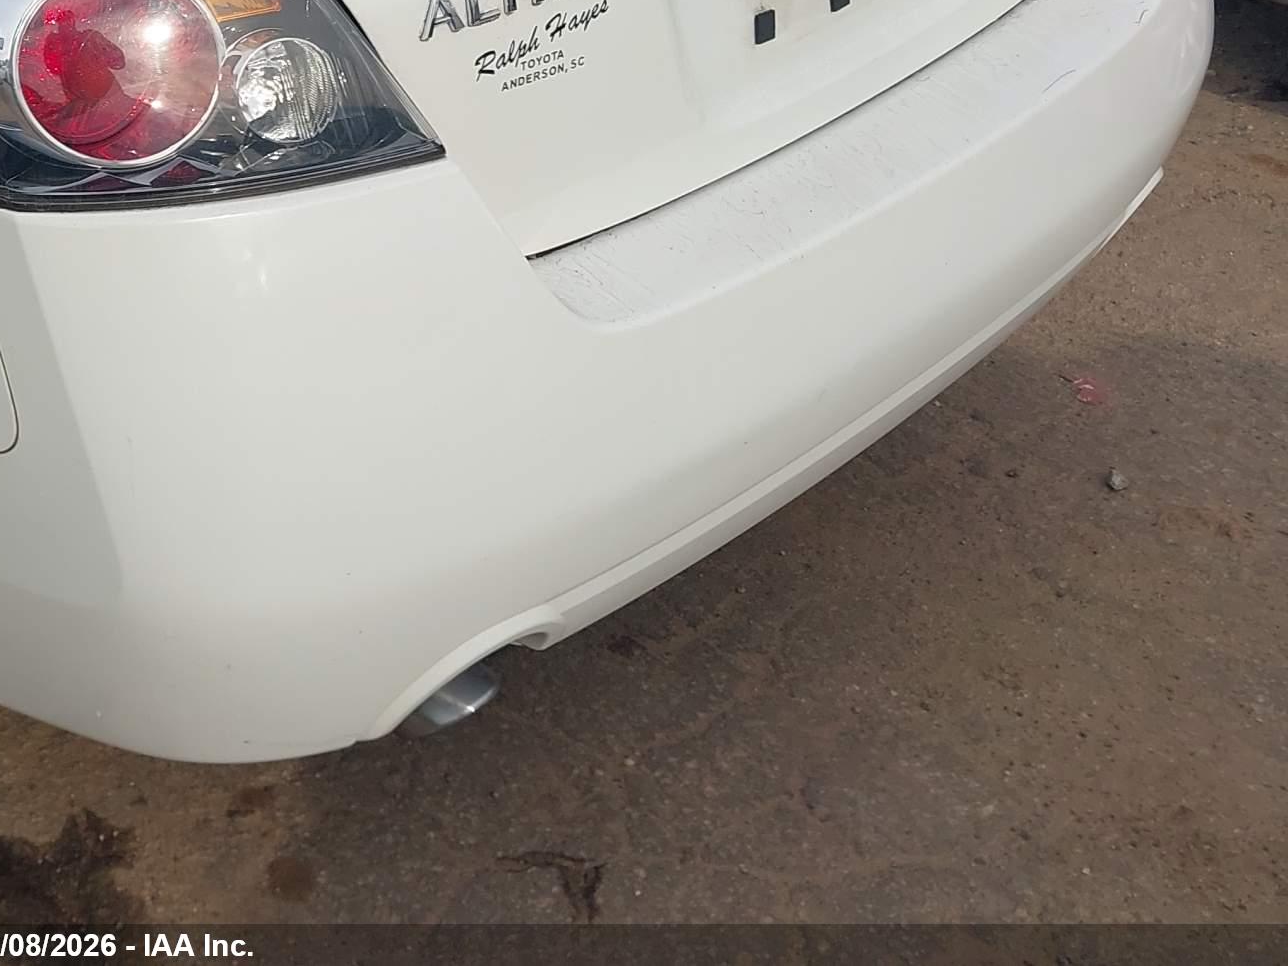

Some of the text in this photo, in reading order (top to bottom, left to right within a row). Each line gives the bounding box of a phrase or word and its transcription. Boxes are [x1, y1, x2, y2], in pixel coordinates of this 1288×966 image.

[474, 26, 540, 81] Ralph
[520, 50, 564, 71] TOYOTA
[501, 56, 585, 92] ANDERSON, SC
